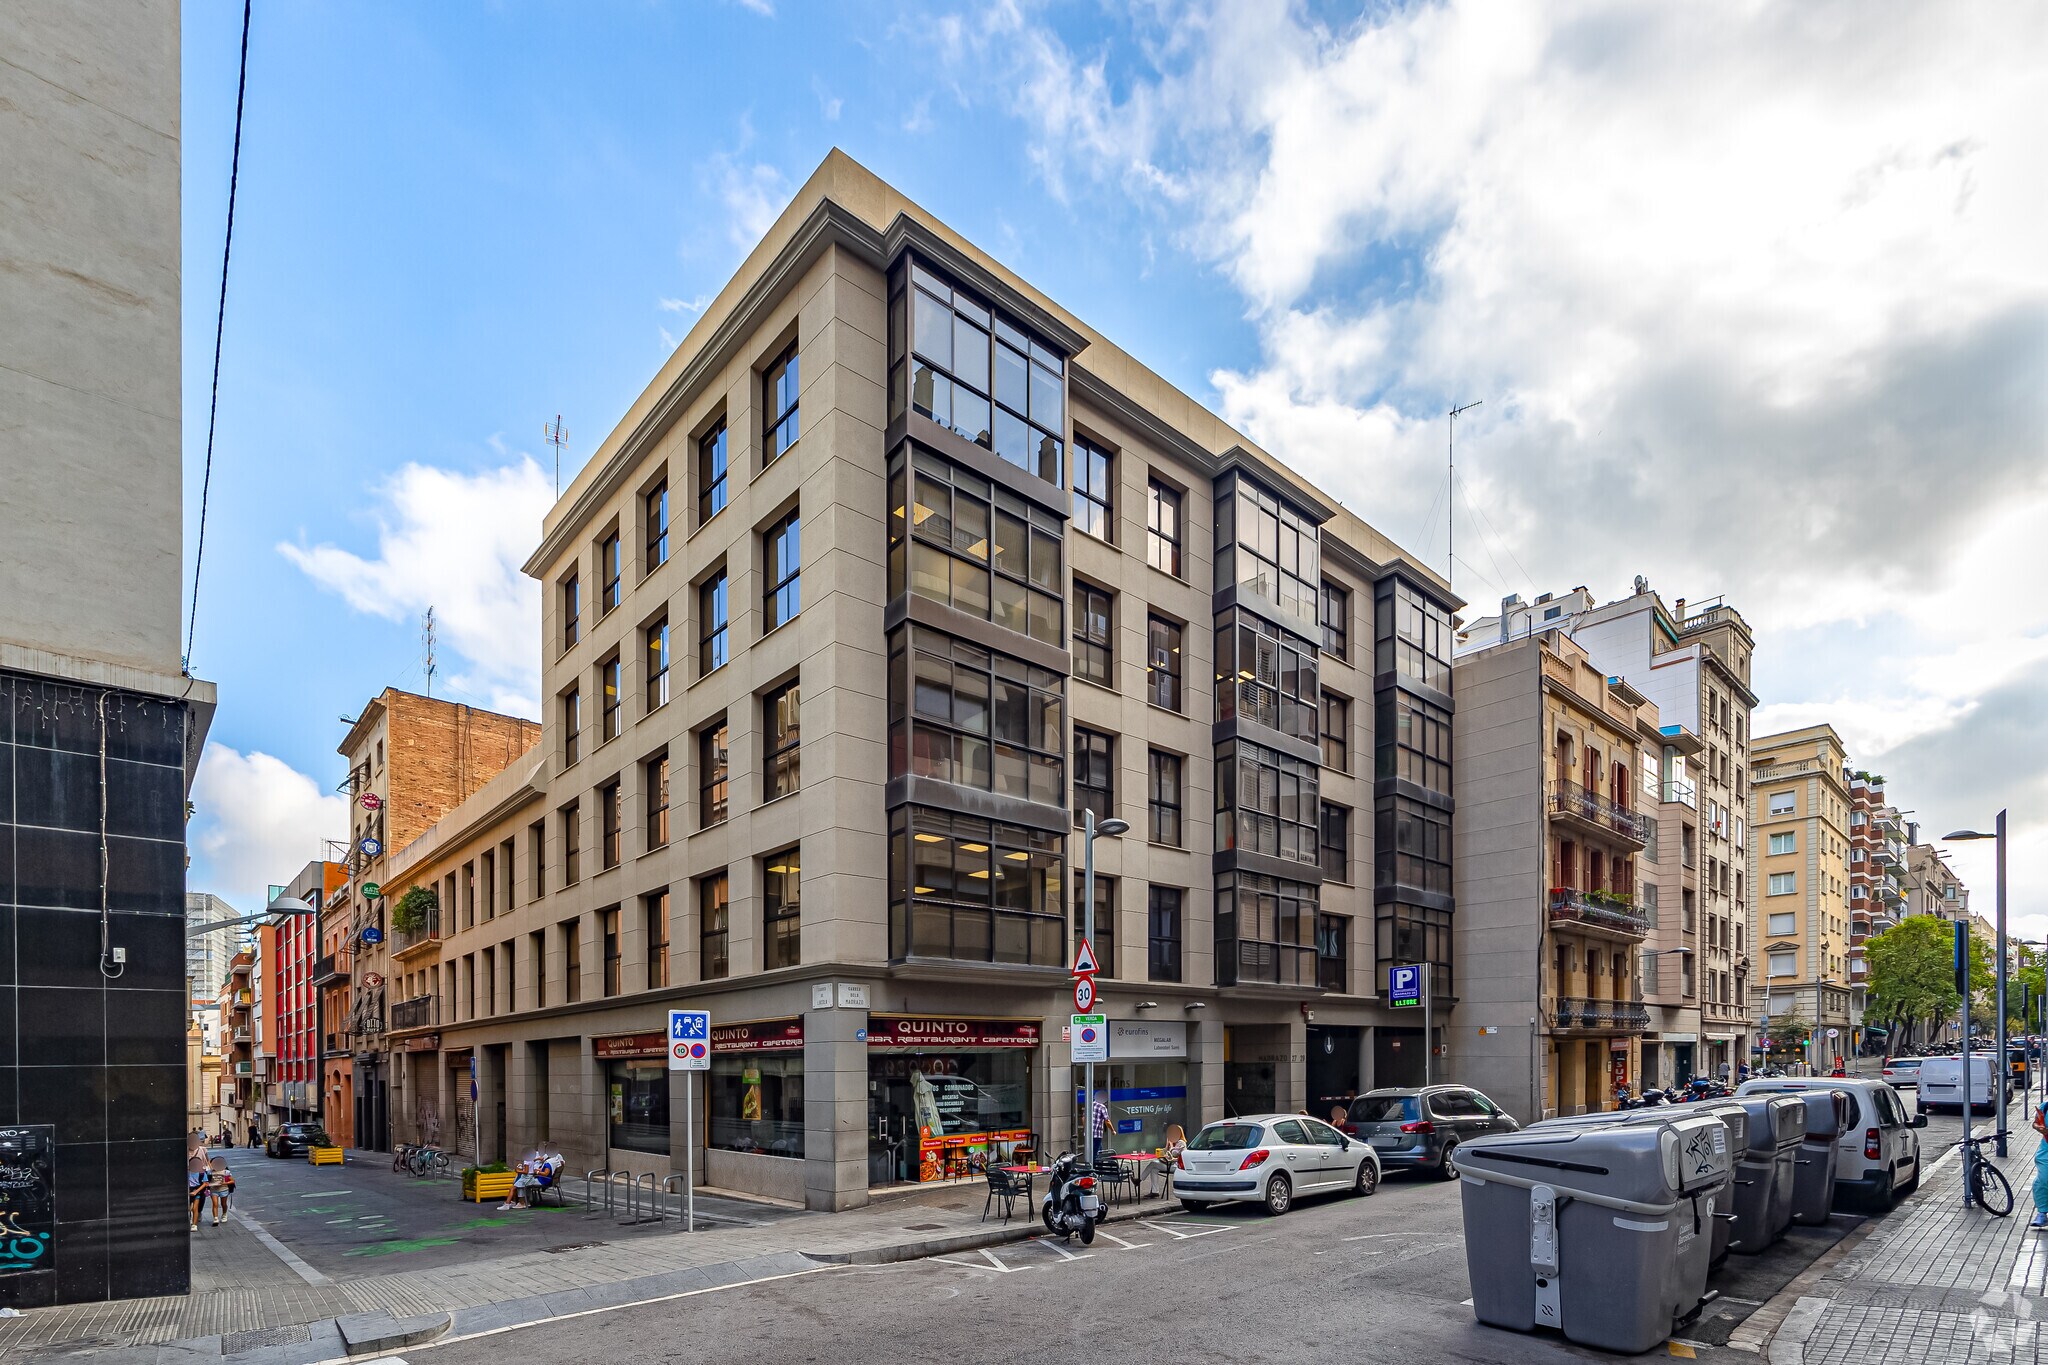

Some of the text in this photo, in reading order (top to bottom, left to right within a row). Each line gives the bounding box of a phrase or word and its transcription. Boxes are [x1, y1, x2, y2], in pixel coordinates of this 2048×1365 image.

[1396, 969, 1413, 989] P
[1078, 987, 1090, 1001] 30
[366, 1018, 380, 1028] OTTO
[898, 1021, 968, 1034] QUINTO
[712, 1028, 749, 1041] QUINTO
[1125, 1027, 1149, 1036] eurofins
[607, 1038, 634, 1048] QUINTO
[715, 1039, 803, 1050] RESTAURANT CAFETERIA
[897, 1036, 978, 1044] RESTAURANT
[1093, 1077, 1130, 1088] eurfins
[1126, 1103, 1173, 1115] TESTING for life
